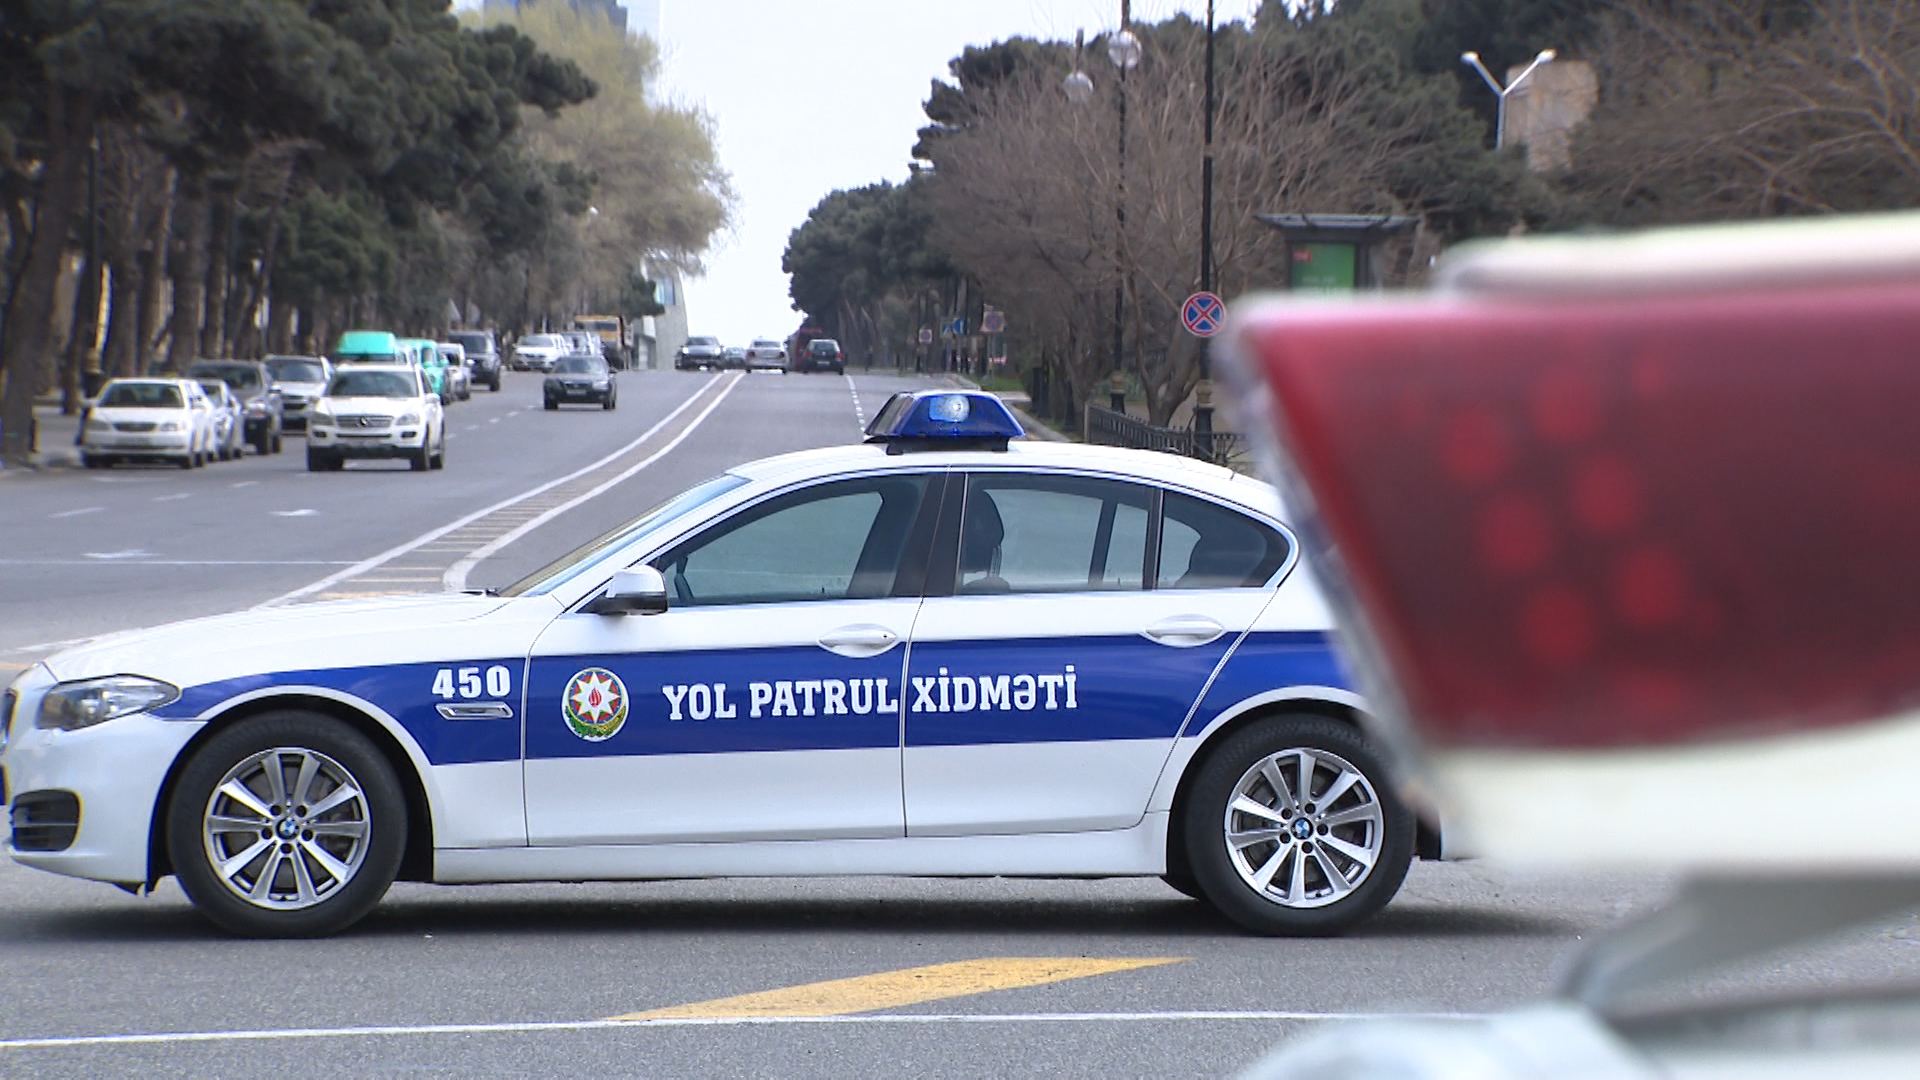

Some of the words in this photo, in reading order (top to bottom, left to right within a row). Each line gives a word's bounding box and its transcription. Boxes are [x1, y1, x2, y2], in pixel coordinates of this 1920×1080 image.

[431, 664, 511, 699] 450
[661, 684, 737, 720] YOL
[748, 678, 899, 718] PATRUL
[911, 664, 1078, 713] XİDMƏTİ
